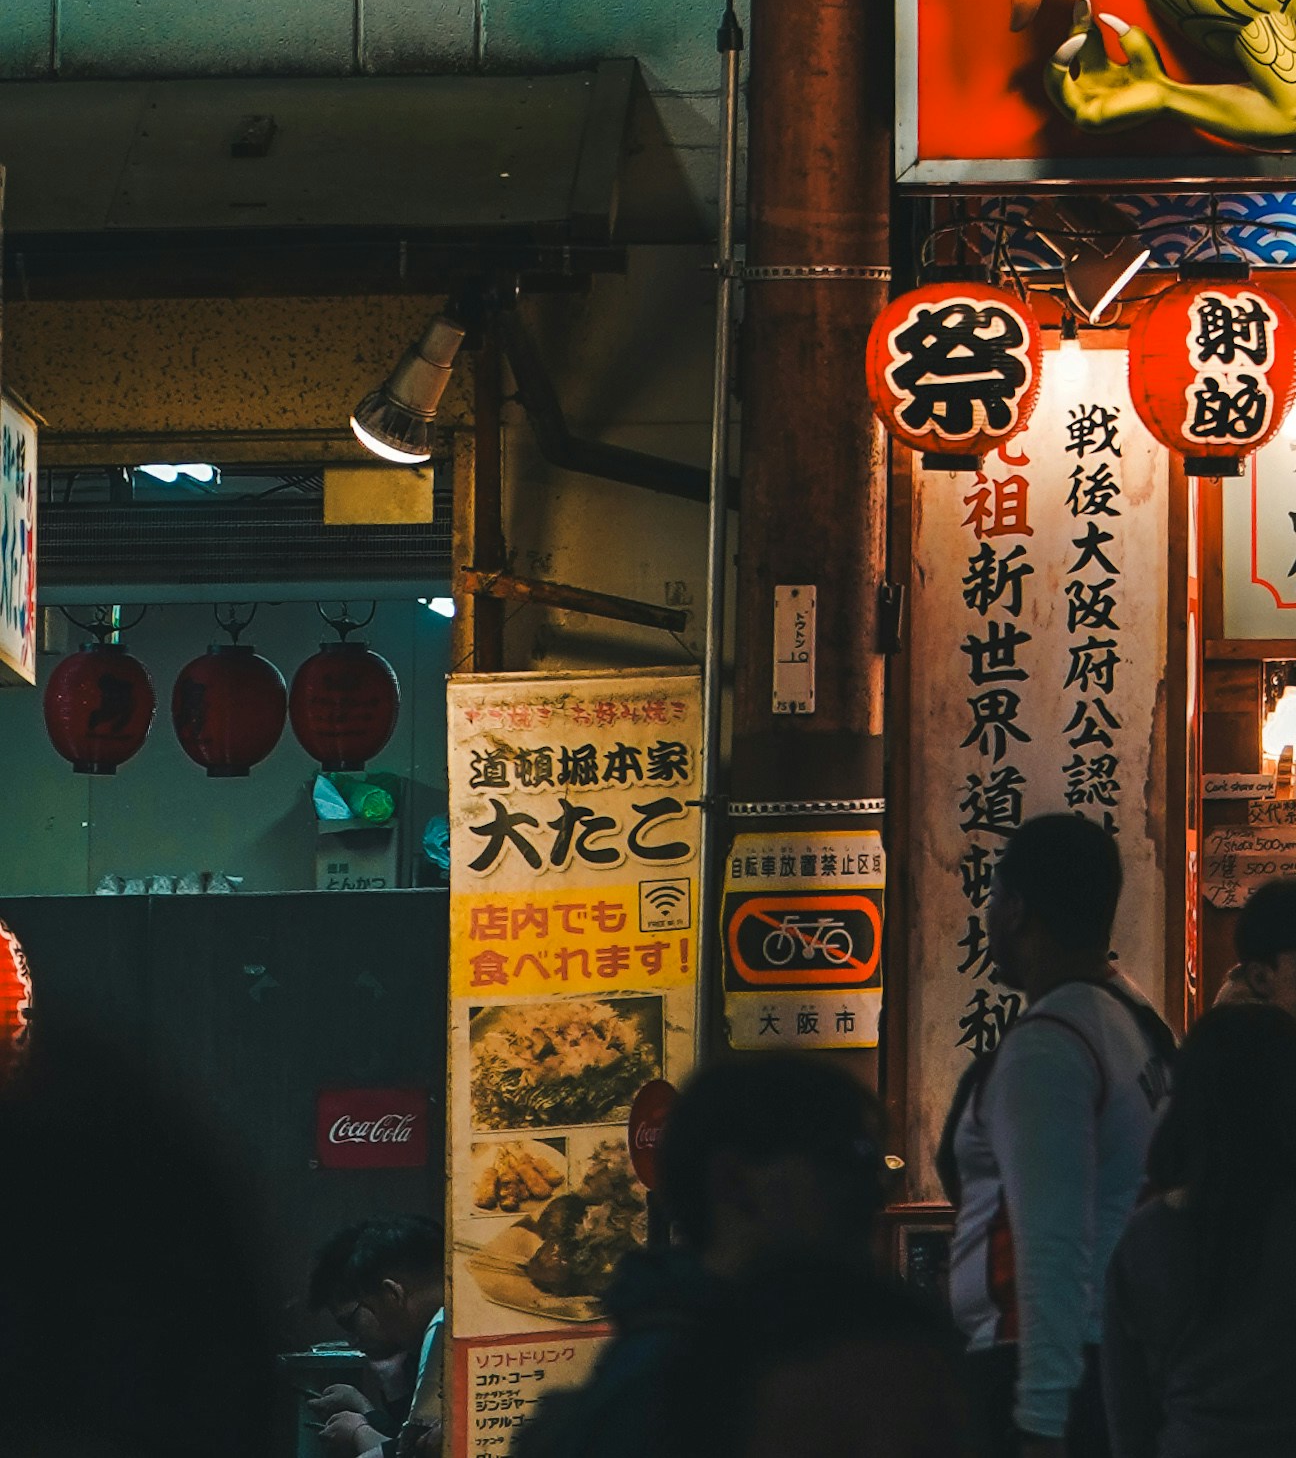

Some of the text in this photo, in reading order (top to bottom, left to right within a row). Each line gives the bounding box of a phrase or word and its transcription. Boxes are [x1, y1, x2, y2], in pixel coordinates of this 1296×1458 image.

[888, 298, 1033, 437] 祭
[1186, 290, 1278, 445] 射的
[1062, 402, 1123, 835] 戦後大阪府公認
[468, 739, 690, 791] 道頓堀本家
[467, 796, 693, 873] 大たこ
[731, 853, 882, 879] 自転車放置禁止区域
[468, 900, 628, 941] 店内でも
[469, 937, 690, 988] 食べれます!
[758, 1010, 856, 1036] 大阪市
[475, 1369, 545, 1387] コカ・コーラ
[476, 1347, 575, 1369] ソフトドリンク
